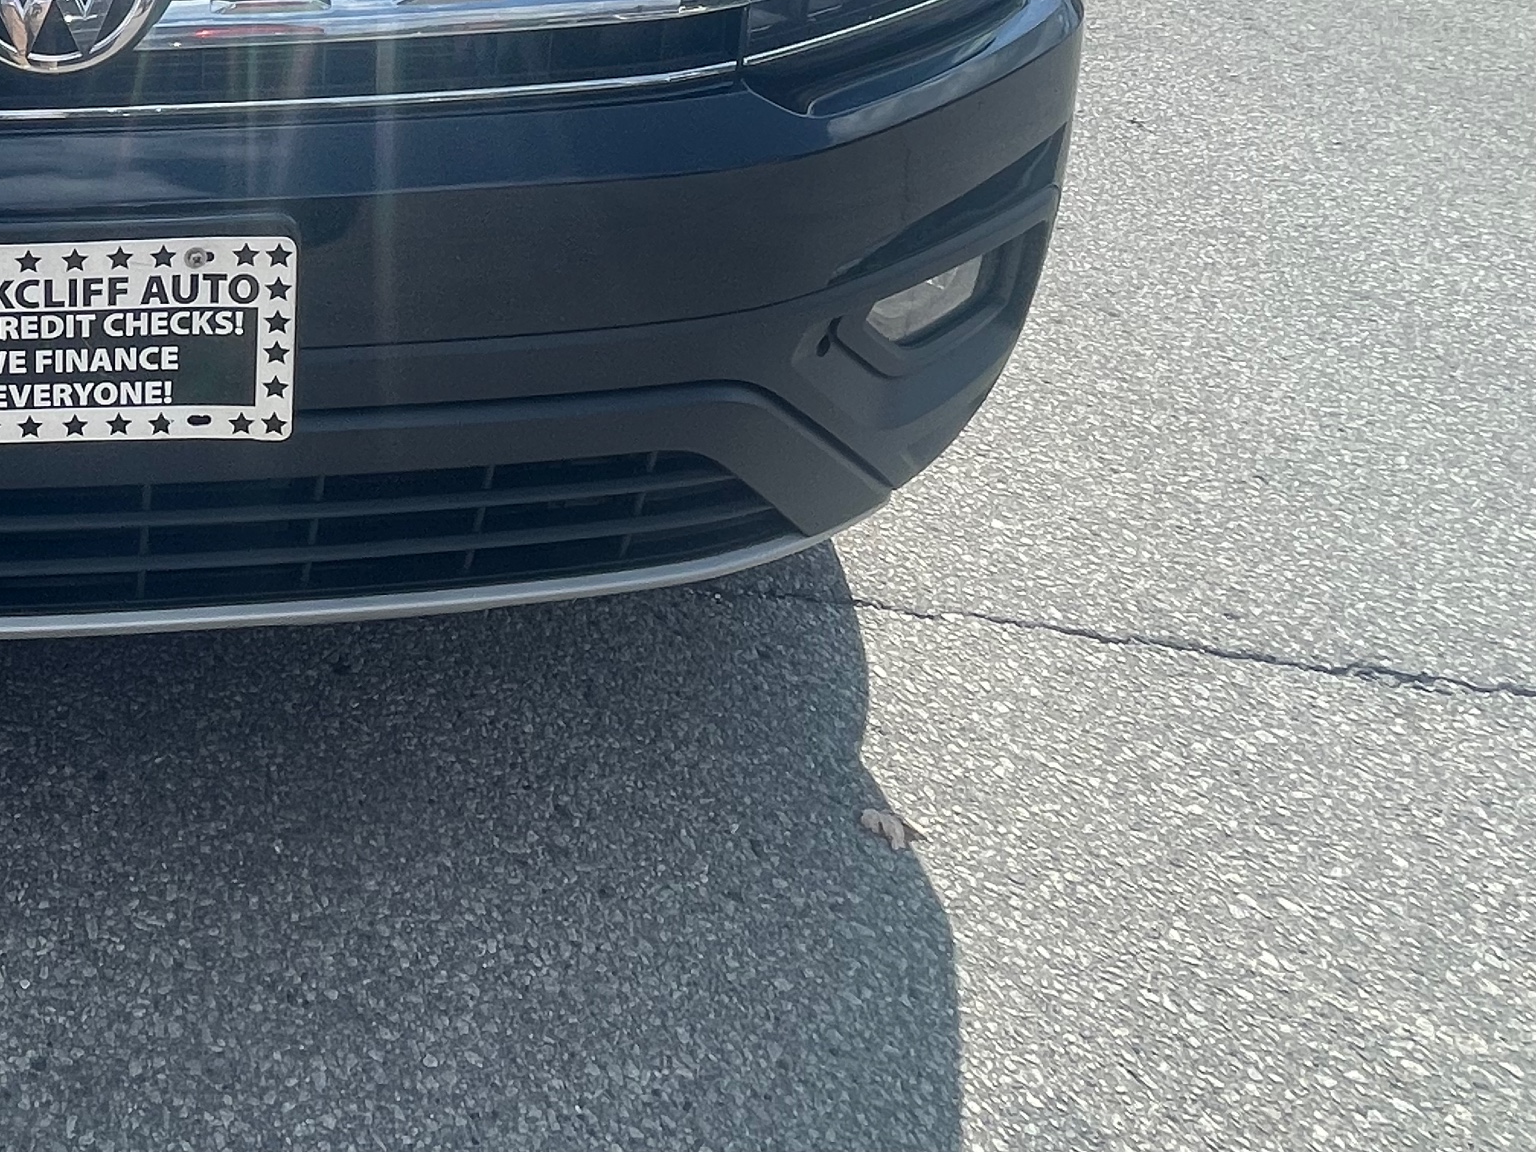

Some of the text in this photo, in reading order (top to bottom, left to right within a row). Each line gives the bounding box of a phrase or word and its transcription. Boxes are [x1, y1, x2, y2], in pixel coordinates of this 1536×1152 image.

[141, 272, 260, 307] AUTO
[102, 310, 245, 338] CHECKS!
[35, 346, 180, 374] FINANCE
